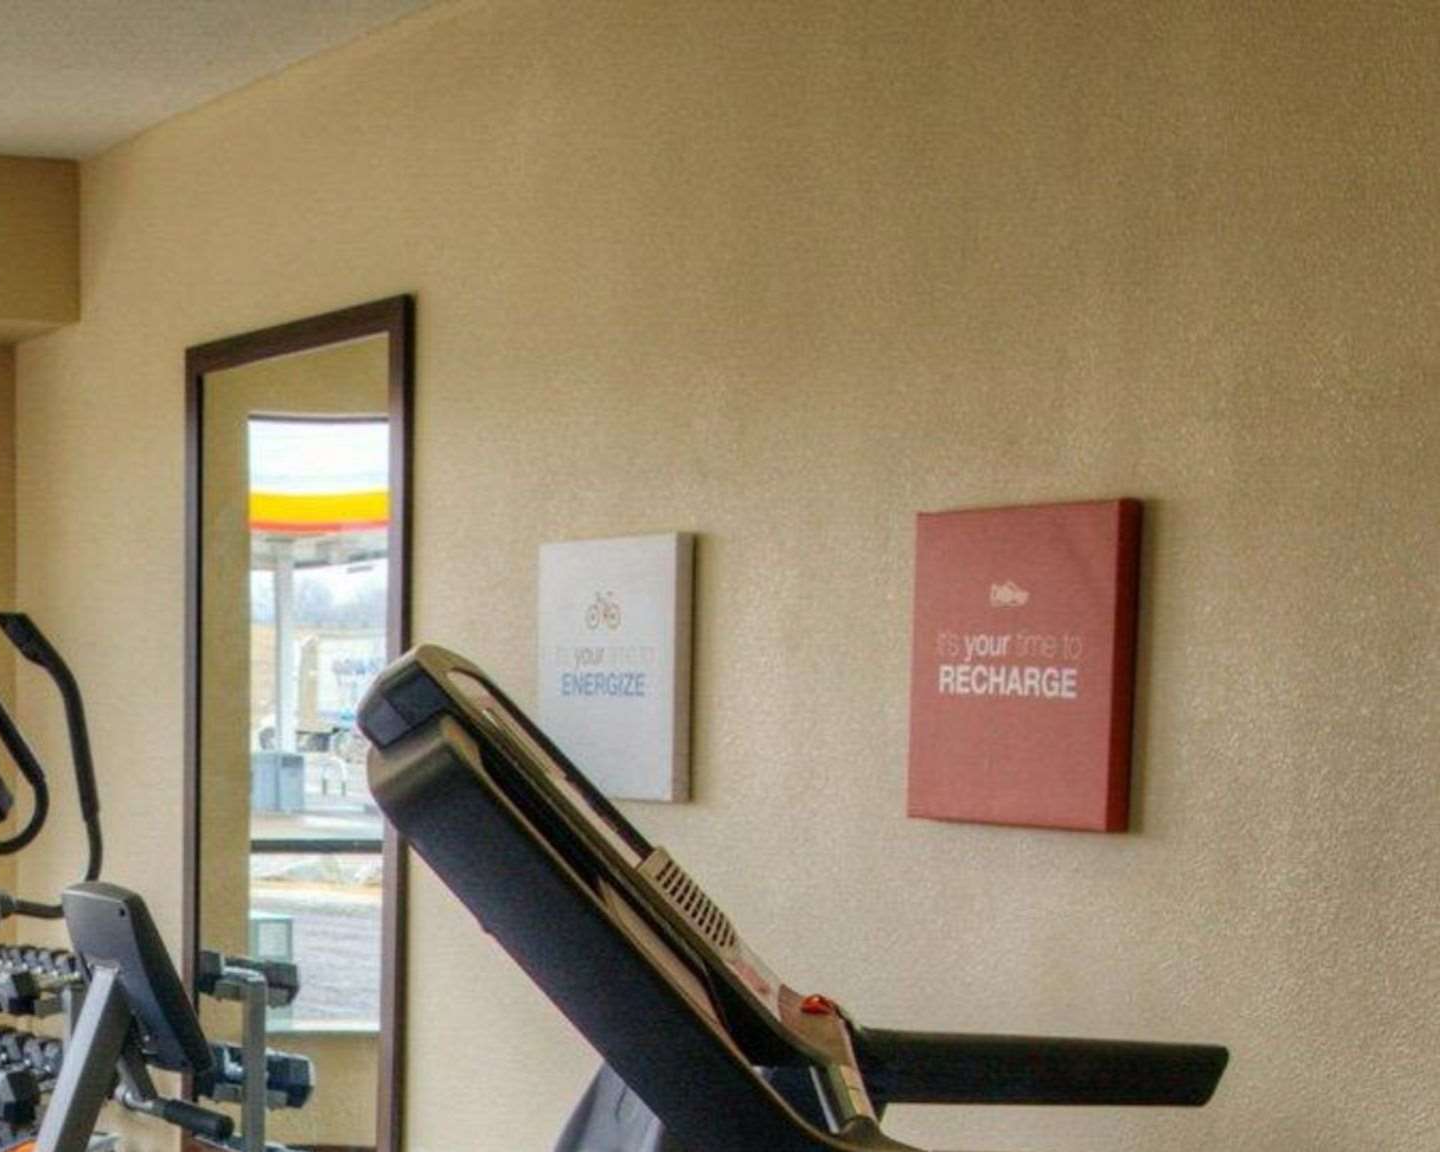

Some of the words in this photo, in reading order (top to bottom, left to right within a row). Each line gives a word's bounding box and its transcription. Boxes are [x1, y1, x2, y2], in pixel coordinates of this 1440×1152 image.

[574, 647, 605, 670] your
[963, 633, 1010, 662] your
[561, 672, 646, 697] ENERGIZE
[938, 664, 1078, 699] RECHARGE
